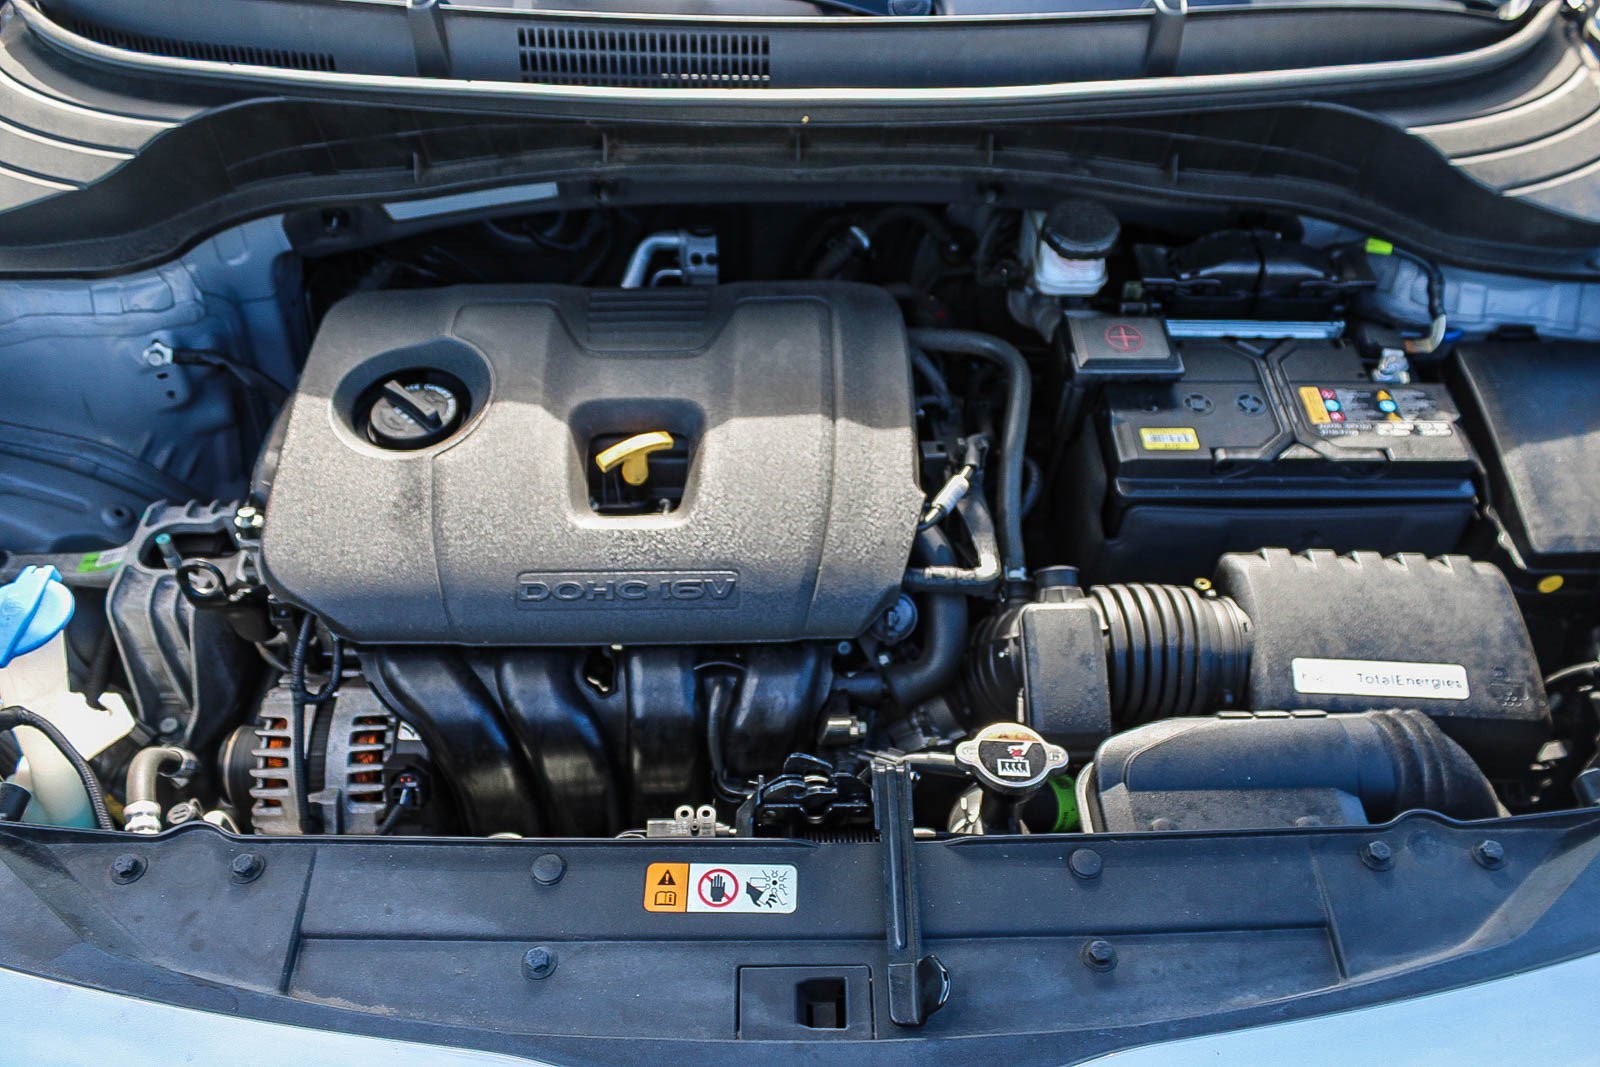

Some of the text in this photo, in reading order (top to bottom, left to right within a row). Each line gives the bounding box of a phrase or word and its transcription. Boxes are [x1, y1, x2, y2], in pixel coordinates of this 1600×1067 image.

[519, 578, 736, 601] DOHC 16V
[1356, 673, 1463, 689] TotalEnergies
